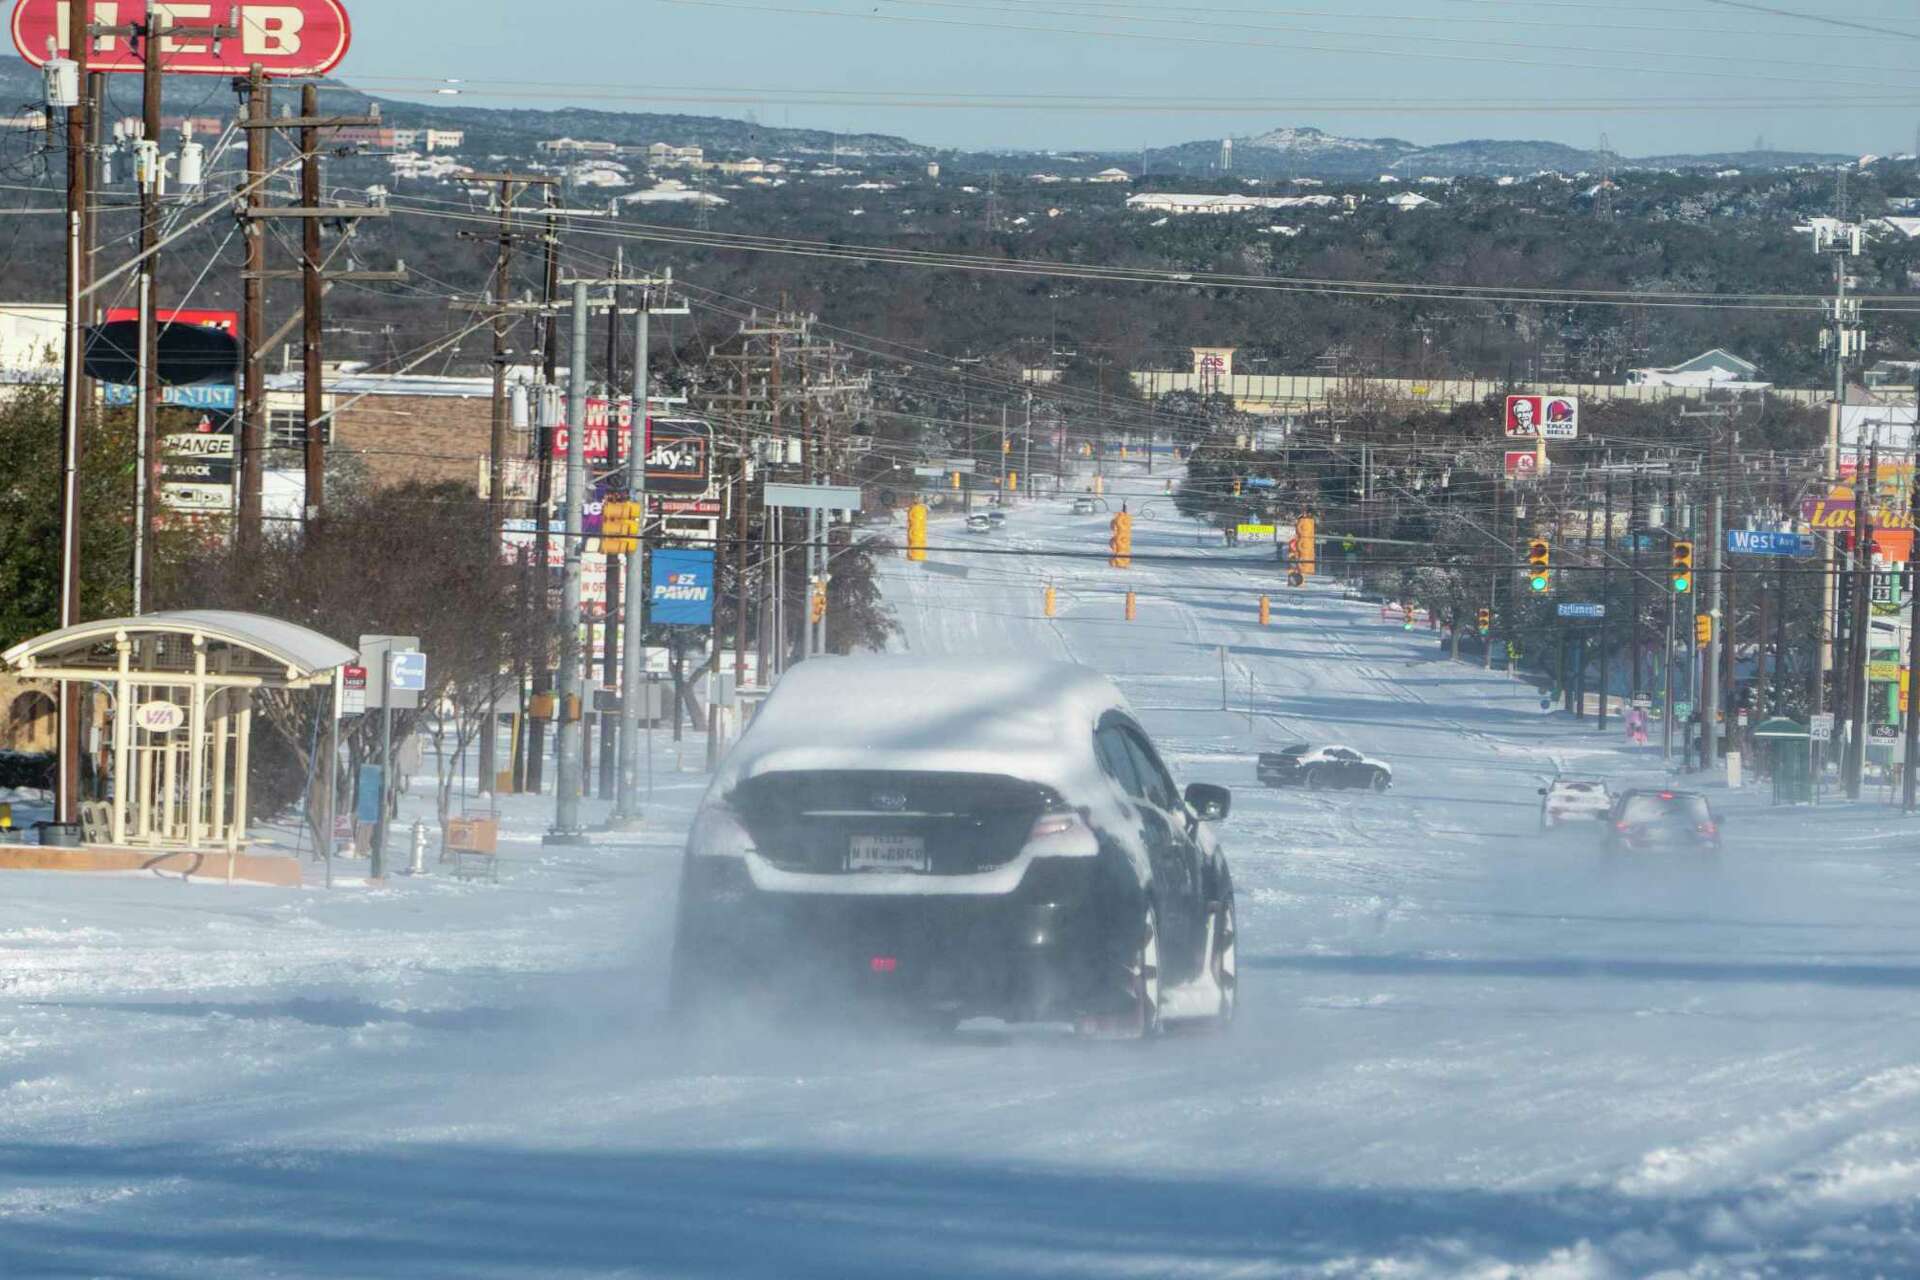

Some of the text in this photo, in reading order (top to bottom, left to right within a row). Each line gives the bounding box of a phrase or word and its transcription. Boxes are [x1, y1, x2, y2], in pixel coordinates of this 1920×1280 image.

[1735, 532, 1775, 549] West
[677, 574, 696, 585] EZ
[653, 585, 709, 601] PAWN
[145, 710, 174, 725] VIA
[1812, 728, 1829, 739] 40
